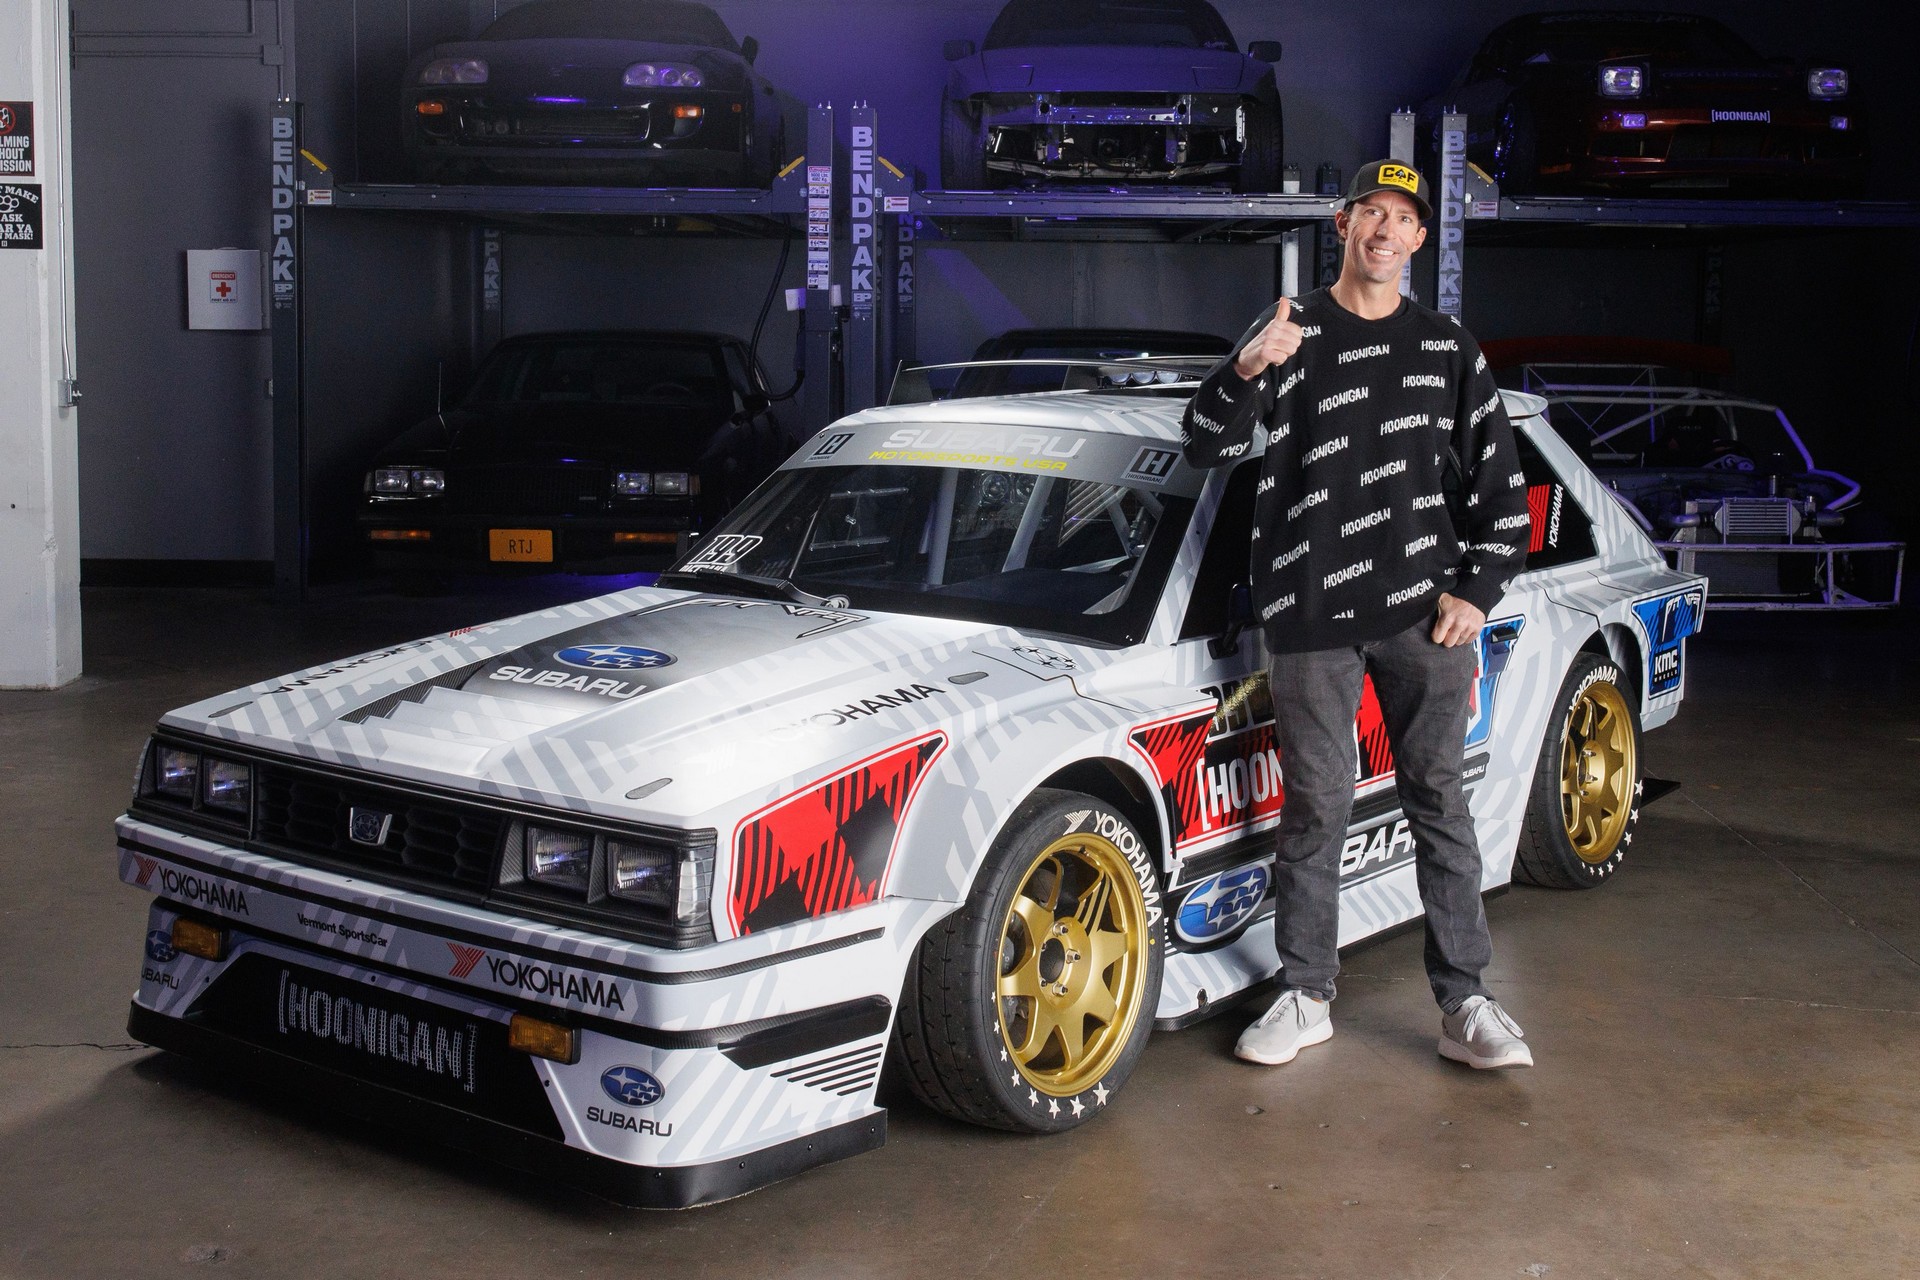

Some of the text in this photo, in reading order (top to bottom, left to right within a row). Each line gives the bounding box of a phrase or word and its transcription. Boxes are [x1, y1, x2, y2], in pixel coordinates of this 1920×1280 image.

[1711, 109, 1770, 123] [HOONIGAN]
[5, 185, 39, 204] MAKE
[272, 117, 294, 281] BENDPAK
[851, 126, 873, 290] BENDPAK
[1439, 130, 1465, 294] BENDPAK
[16, 224, 33, 233] YA
[1338, 344, 1390, 365] HOONIGAN
[1402, 374, 1446, 389] HOONIGAN
[1318, 386, 1369, 415] HOONIGAN
[1380, 413, 1429, 436] HOONIGAN
[881, 429, 1087, 458] SUBARU
[1302, 435, 1349, 469] HOONIGAN
[868, 451, 1069, 472] MOTORSPORTS USA
[1360, 459, 1407, 487] HOONIGAN
[1287, 488, 1329, 522] HOONIGAN
[1548, 483, 1564, 549] YOKOHAMA
[1341, 507, 1391, 538] HOONIGAN
[508, 539, 533, 554] RTJ
[1272, 540, 1310, 572] HOONIGAN
[1323, 558, 1373, 590] HOONIGAN
[1262, 592, 1296, 622] HOONIGAN
[1386, 578, 1435, 607] HOONIGAN
[1654, 648, 1678, 675] KMC
[489, 665, 648, 699] SUBARU
[1093, 810, 1162, 928] YOKOHAMA
[158, 865, 249, 916] YOKOHAMA
[297, 912, 388, 947] Vermont SportsCar
[486, 955, 625, 1012] YOKOHAMA
[278, 969, 478, 1094] [HOONIGAN]
[586, 1106, 673, 1137] SUBARU
